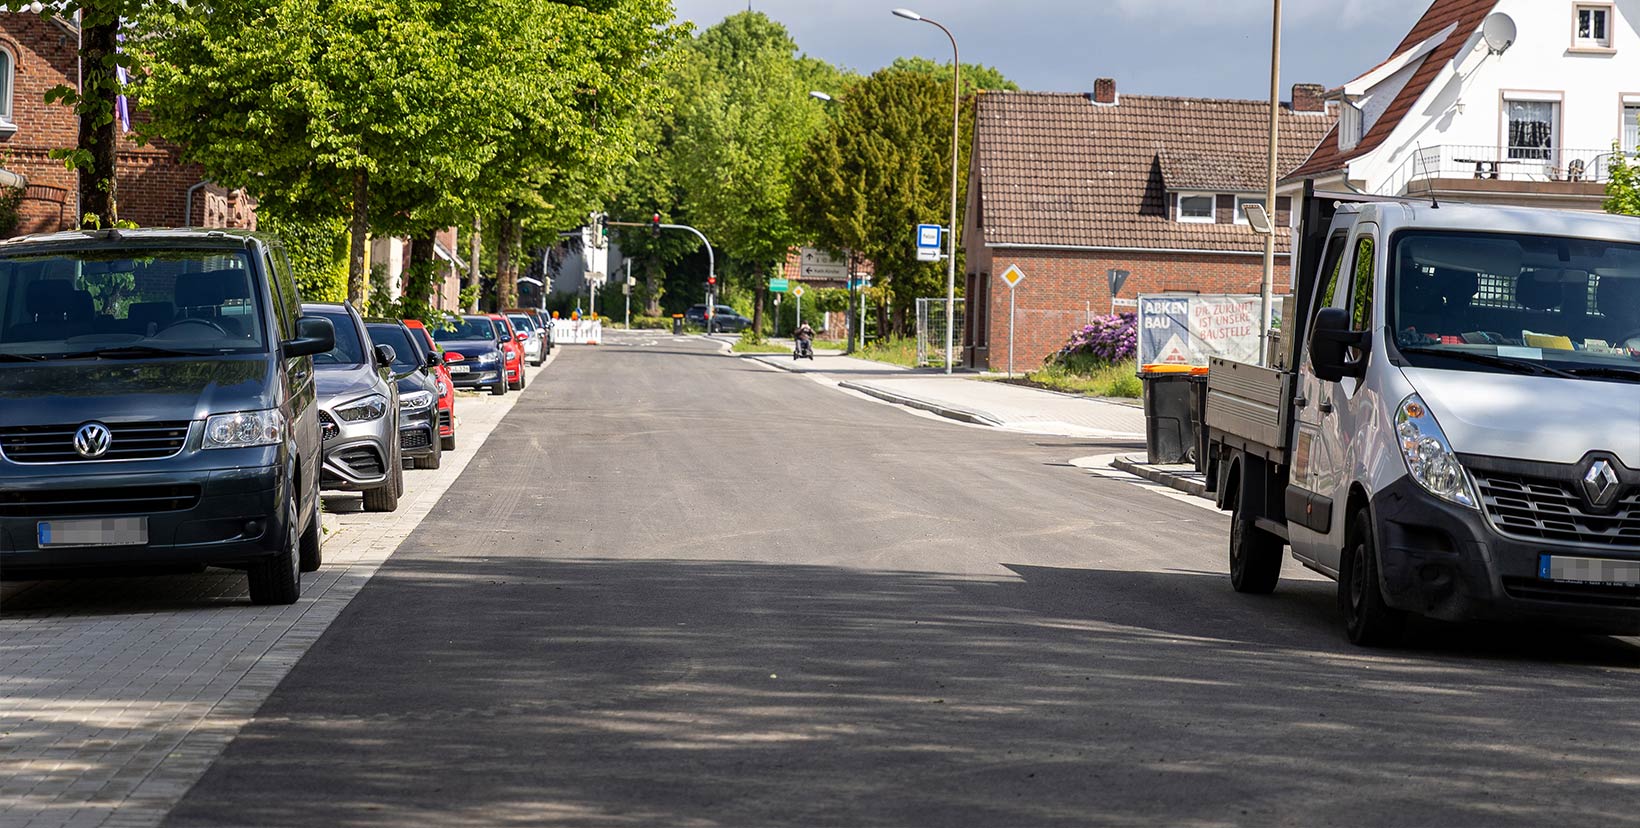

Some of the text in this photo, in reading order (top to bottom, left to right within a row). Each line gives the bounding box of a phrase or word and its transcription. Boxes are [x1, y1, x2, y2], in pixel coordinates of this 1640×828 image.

[1144, 301, 1188, 315] ABKEN
[1144, 317, 1171, 329] BAU
[1199, 312, 1250, 328] IST UNSERE
[1200, 326, 1251, 340] BAUSTELLE
